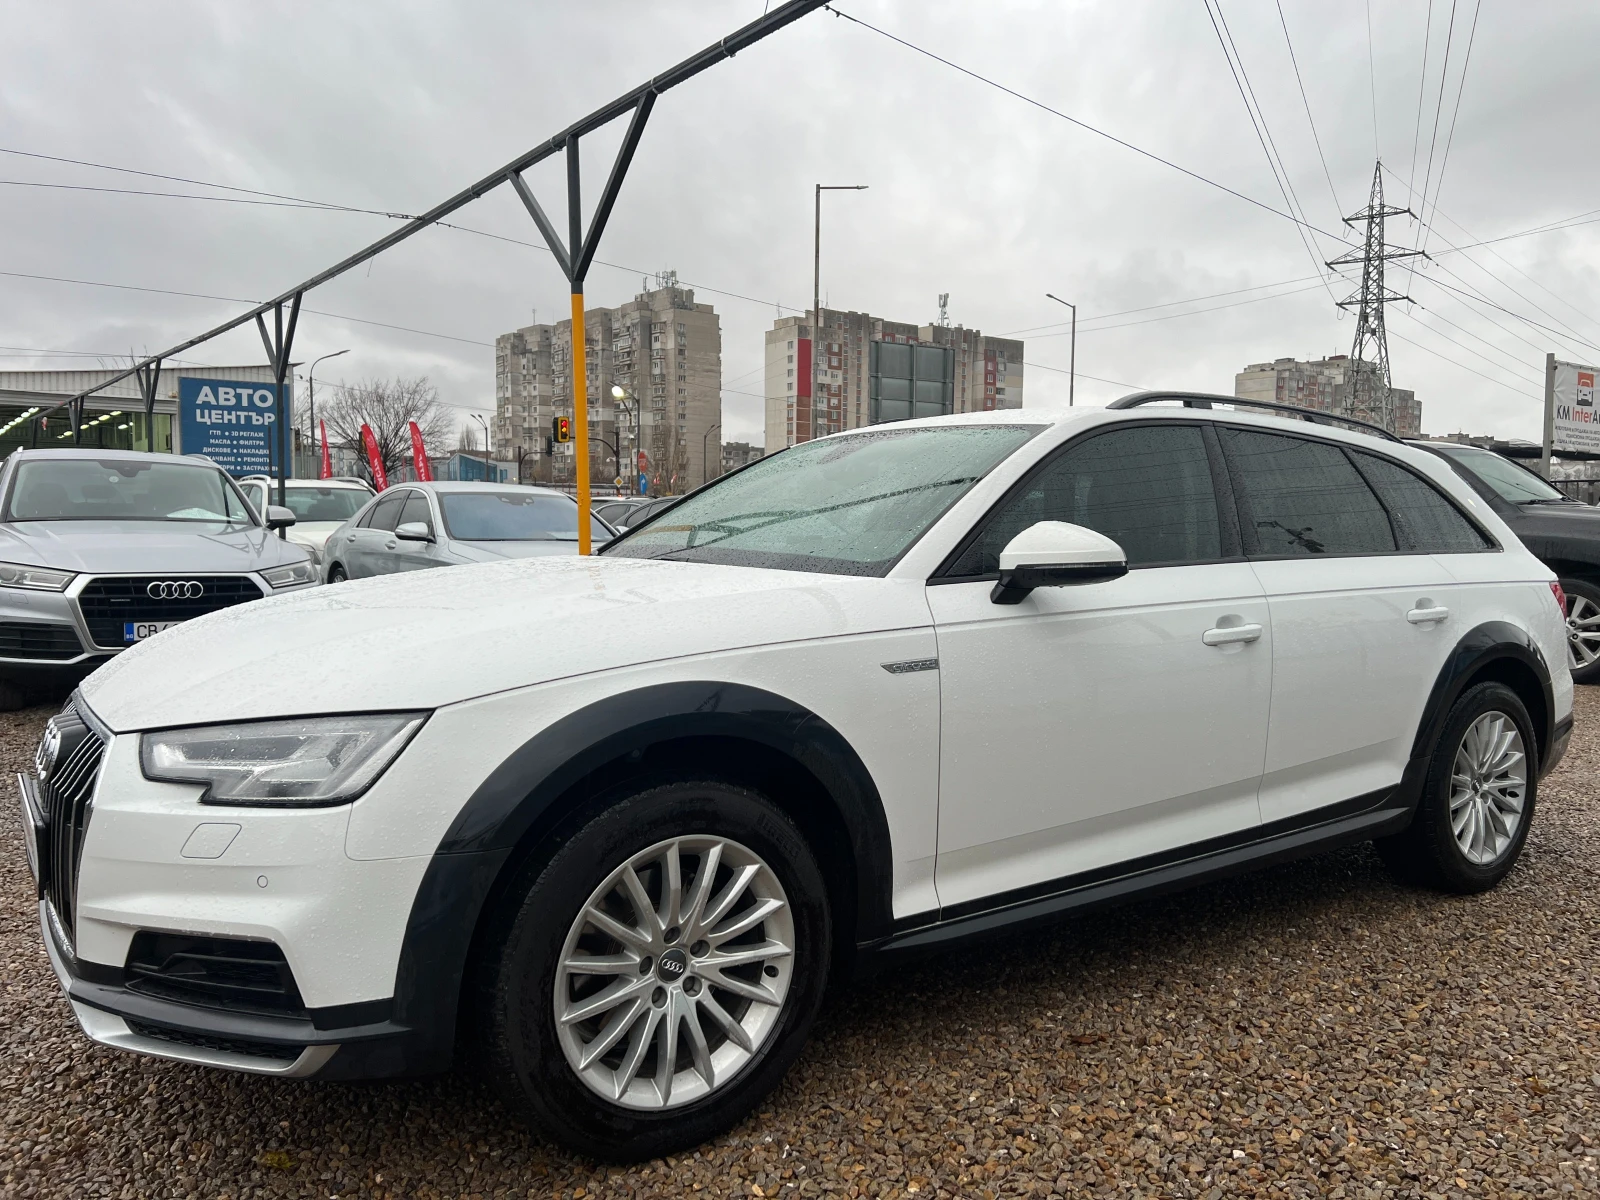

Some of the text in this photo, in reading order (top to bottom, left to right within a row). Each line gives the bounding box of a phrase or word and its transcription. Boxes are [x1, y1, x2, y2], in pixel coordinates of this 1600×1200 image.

[196, 386, 274, 408] АВТО
[196, 408, 275, 426] ЦЕНТЪР
[1556, 404, 1571, 421] KM
